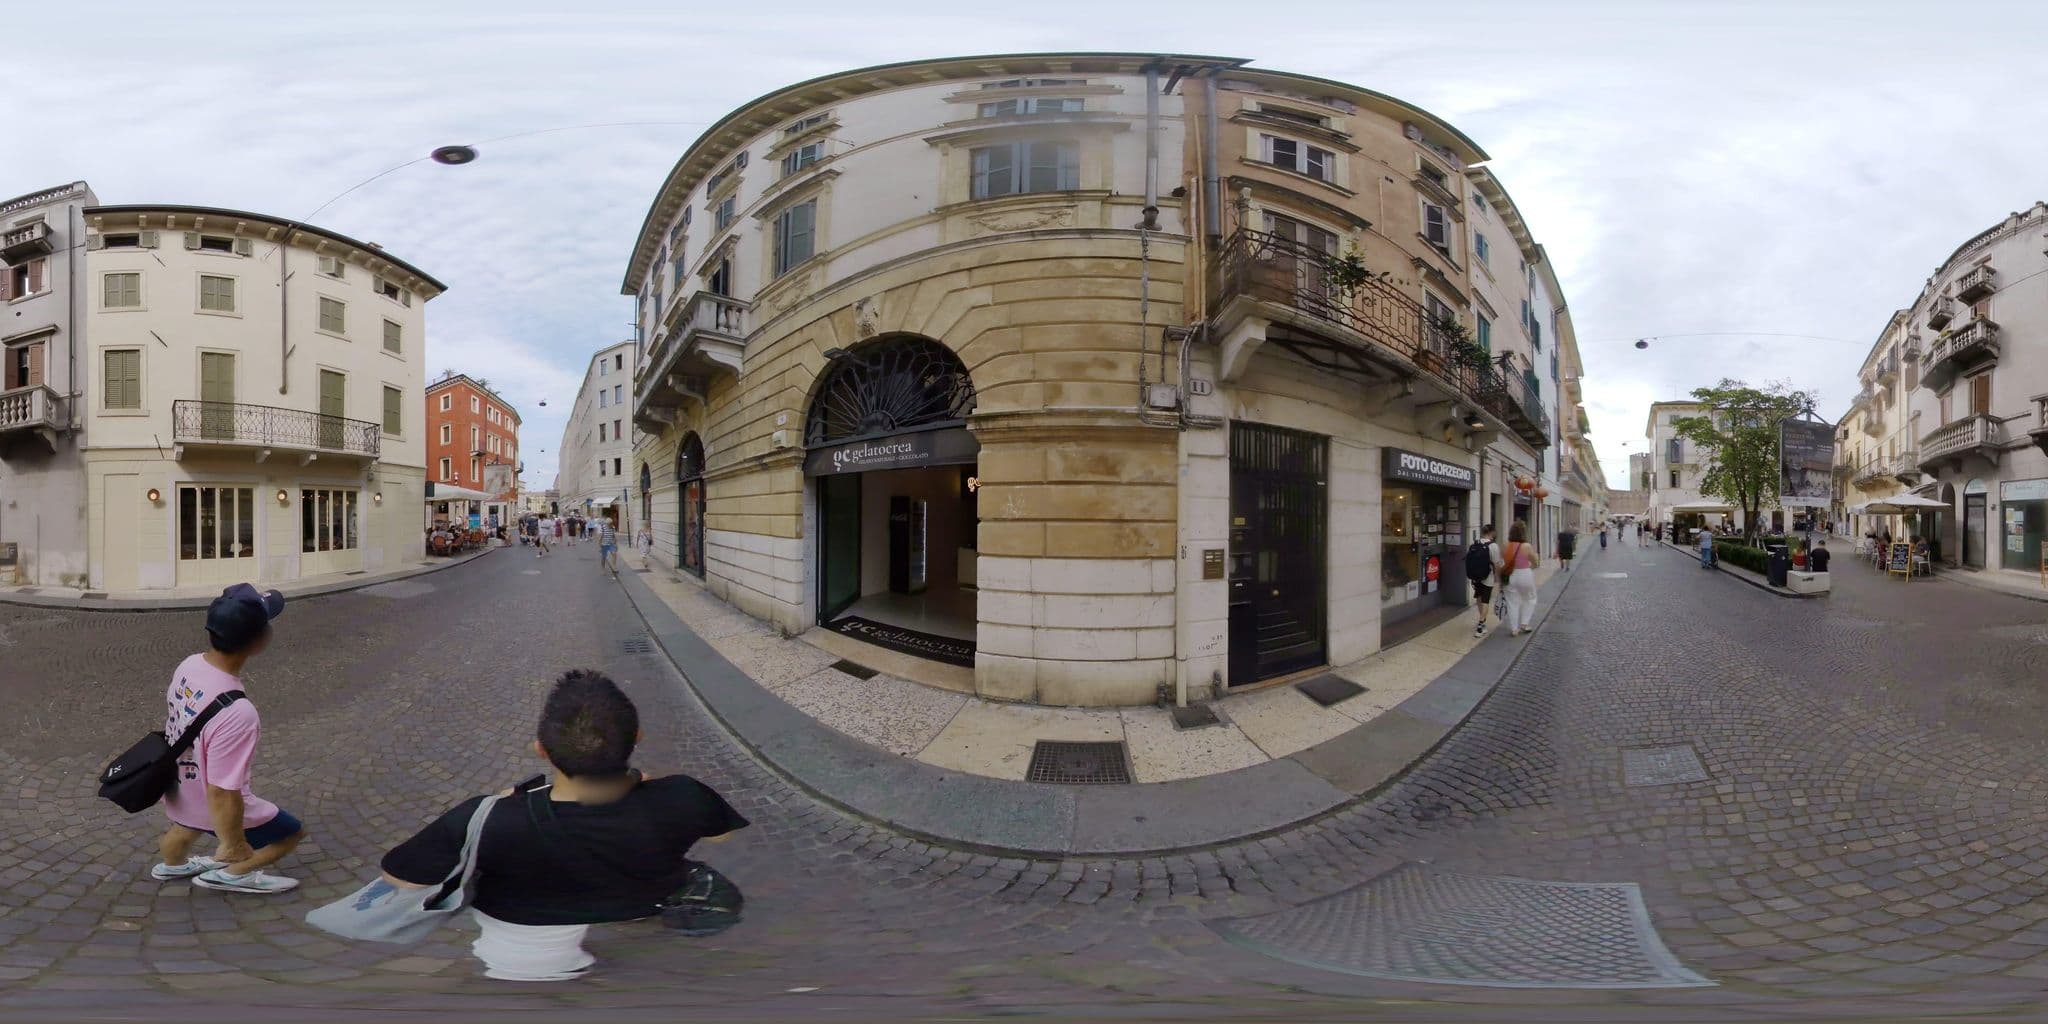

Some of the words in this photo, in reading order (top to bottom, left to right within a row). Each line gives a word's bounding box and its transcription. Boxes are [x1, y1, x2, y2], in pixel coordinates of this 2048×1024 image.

[1193, 381, 1205, 394] 11
[833, 449, 851, 472] gc
[852, 442, 912, 464] gelatocrea
[1400, 453, 1429, 472] FOTO
[1430, 461, 1471, 481] GORZEGNO
